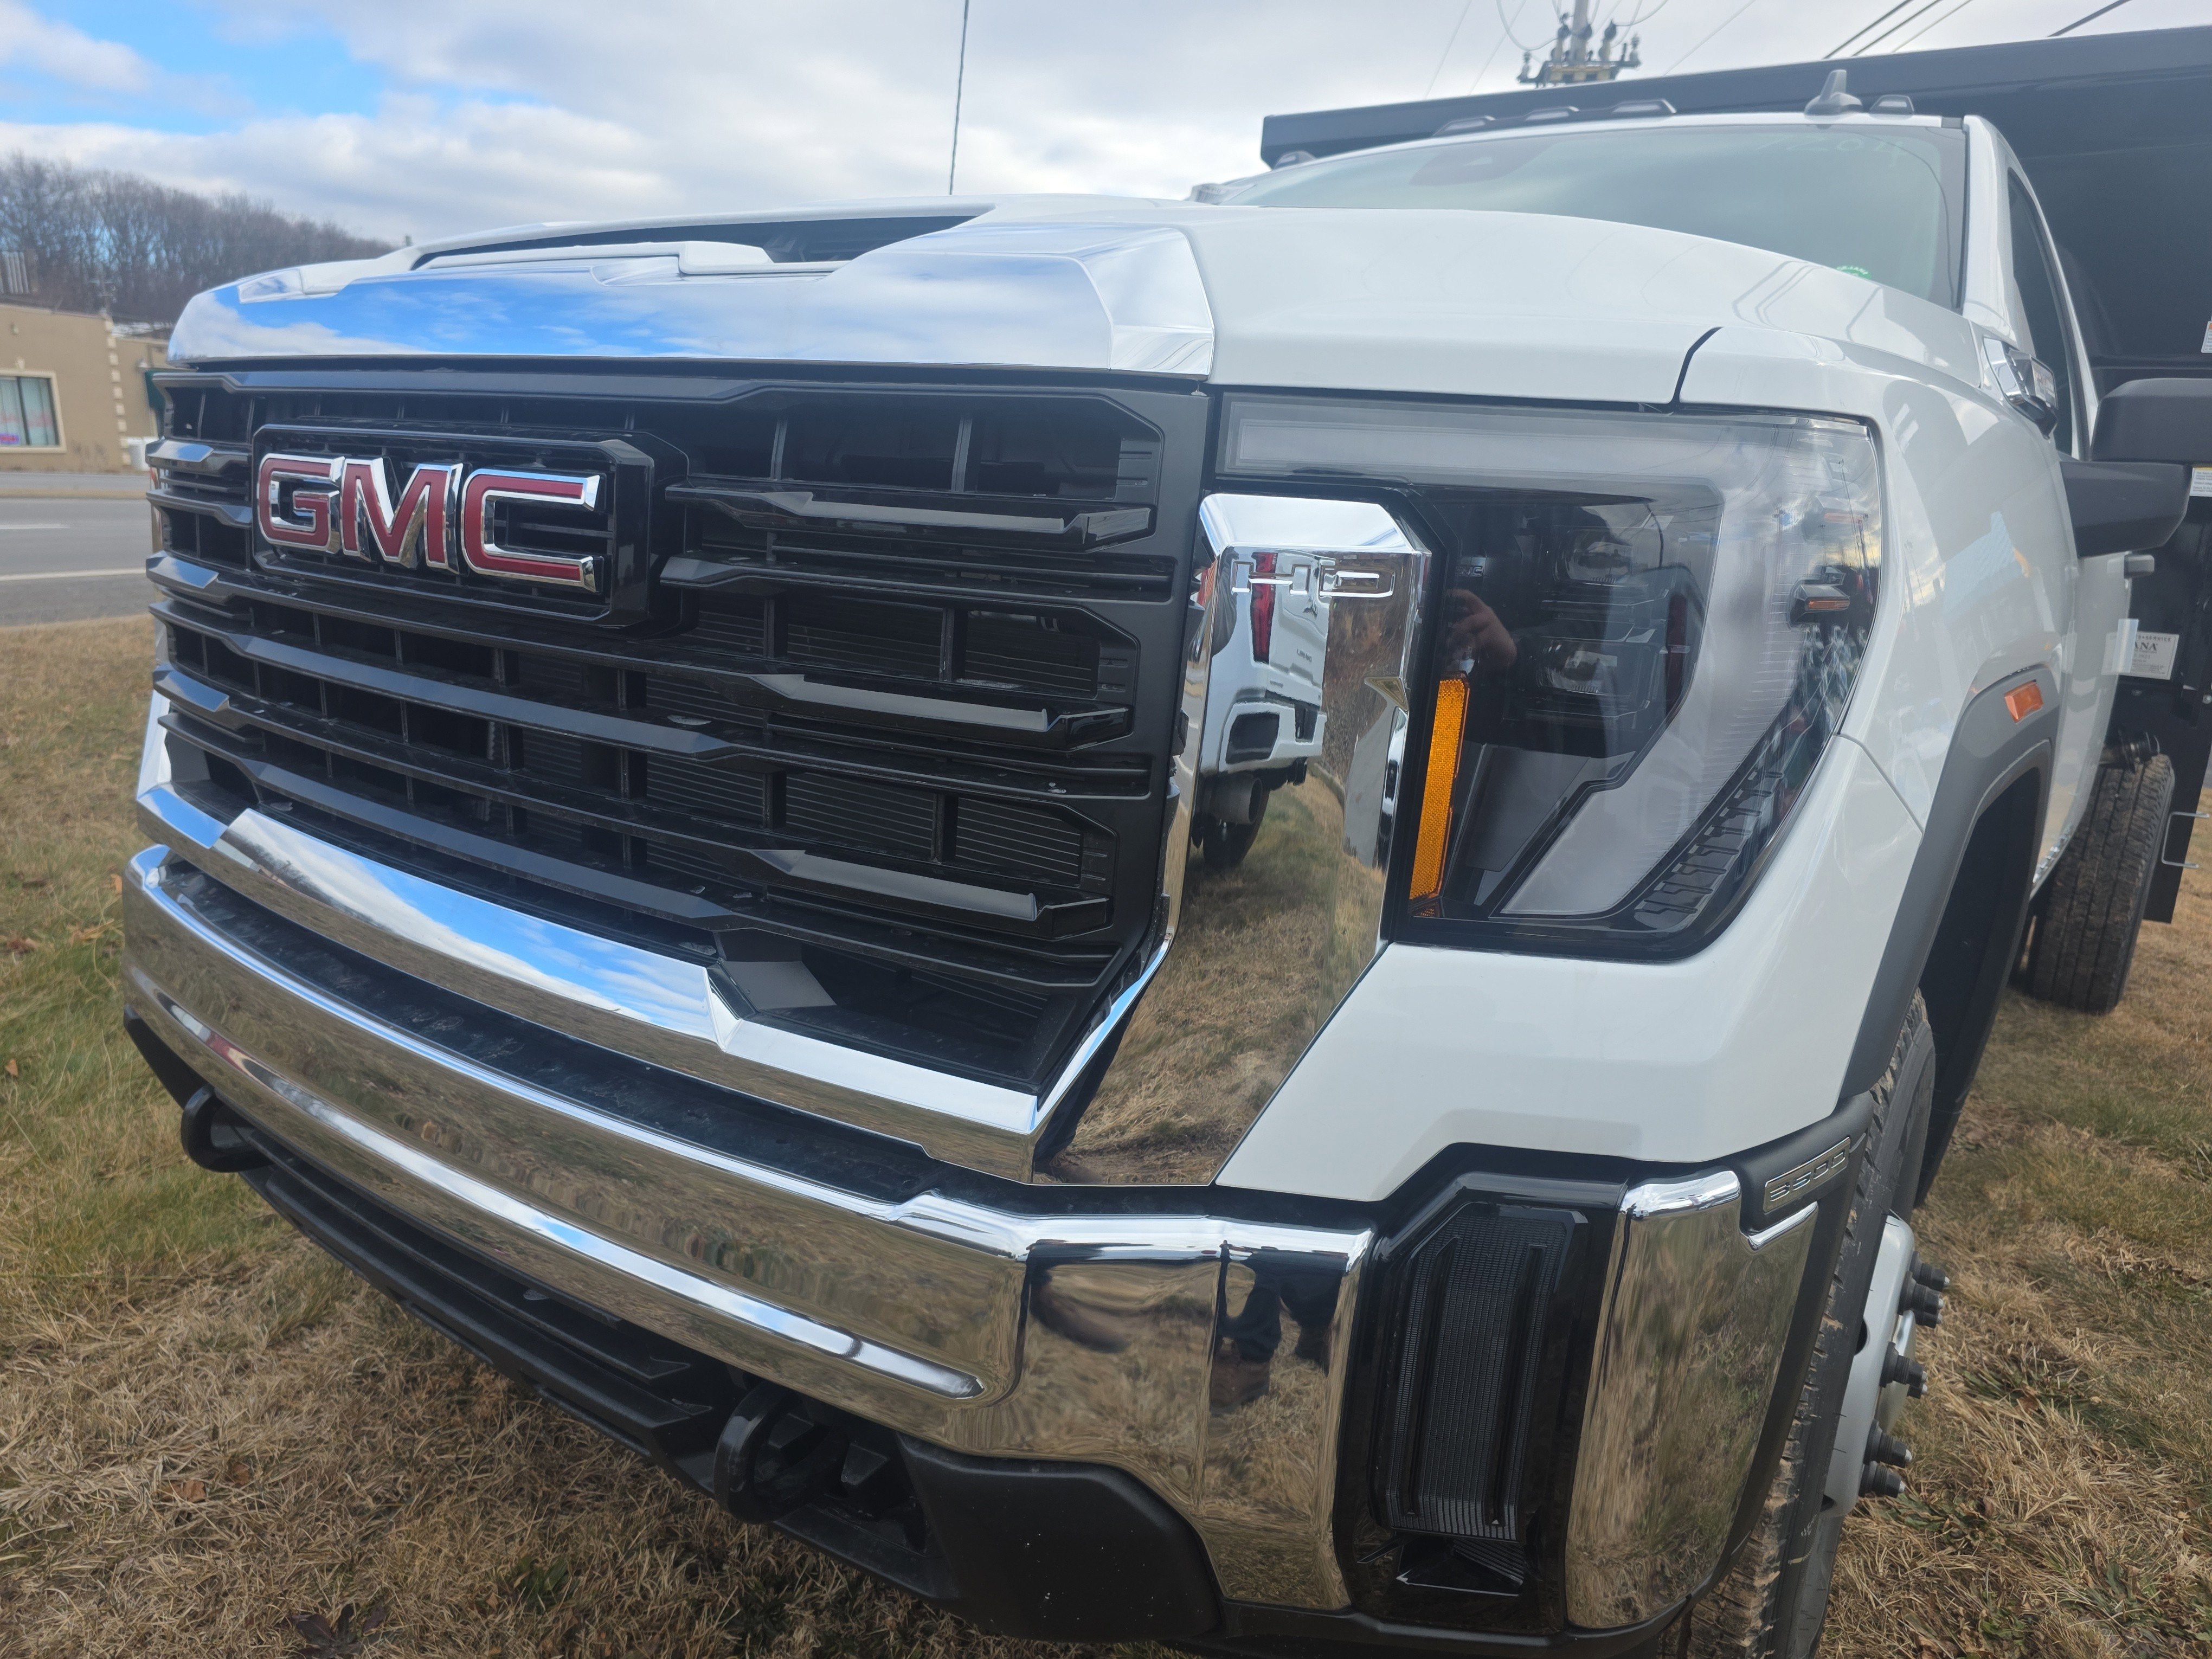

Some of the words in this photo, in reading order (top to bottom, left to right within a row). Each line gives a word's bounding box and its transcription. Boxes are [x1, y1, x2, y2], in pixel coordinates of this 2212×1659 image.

[256, 452, 600, 593] GMC
[2134, 641, 2157, 651] ANA
[1770, 1149, 1846, 1203] 3500
